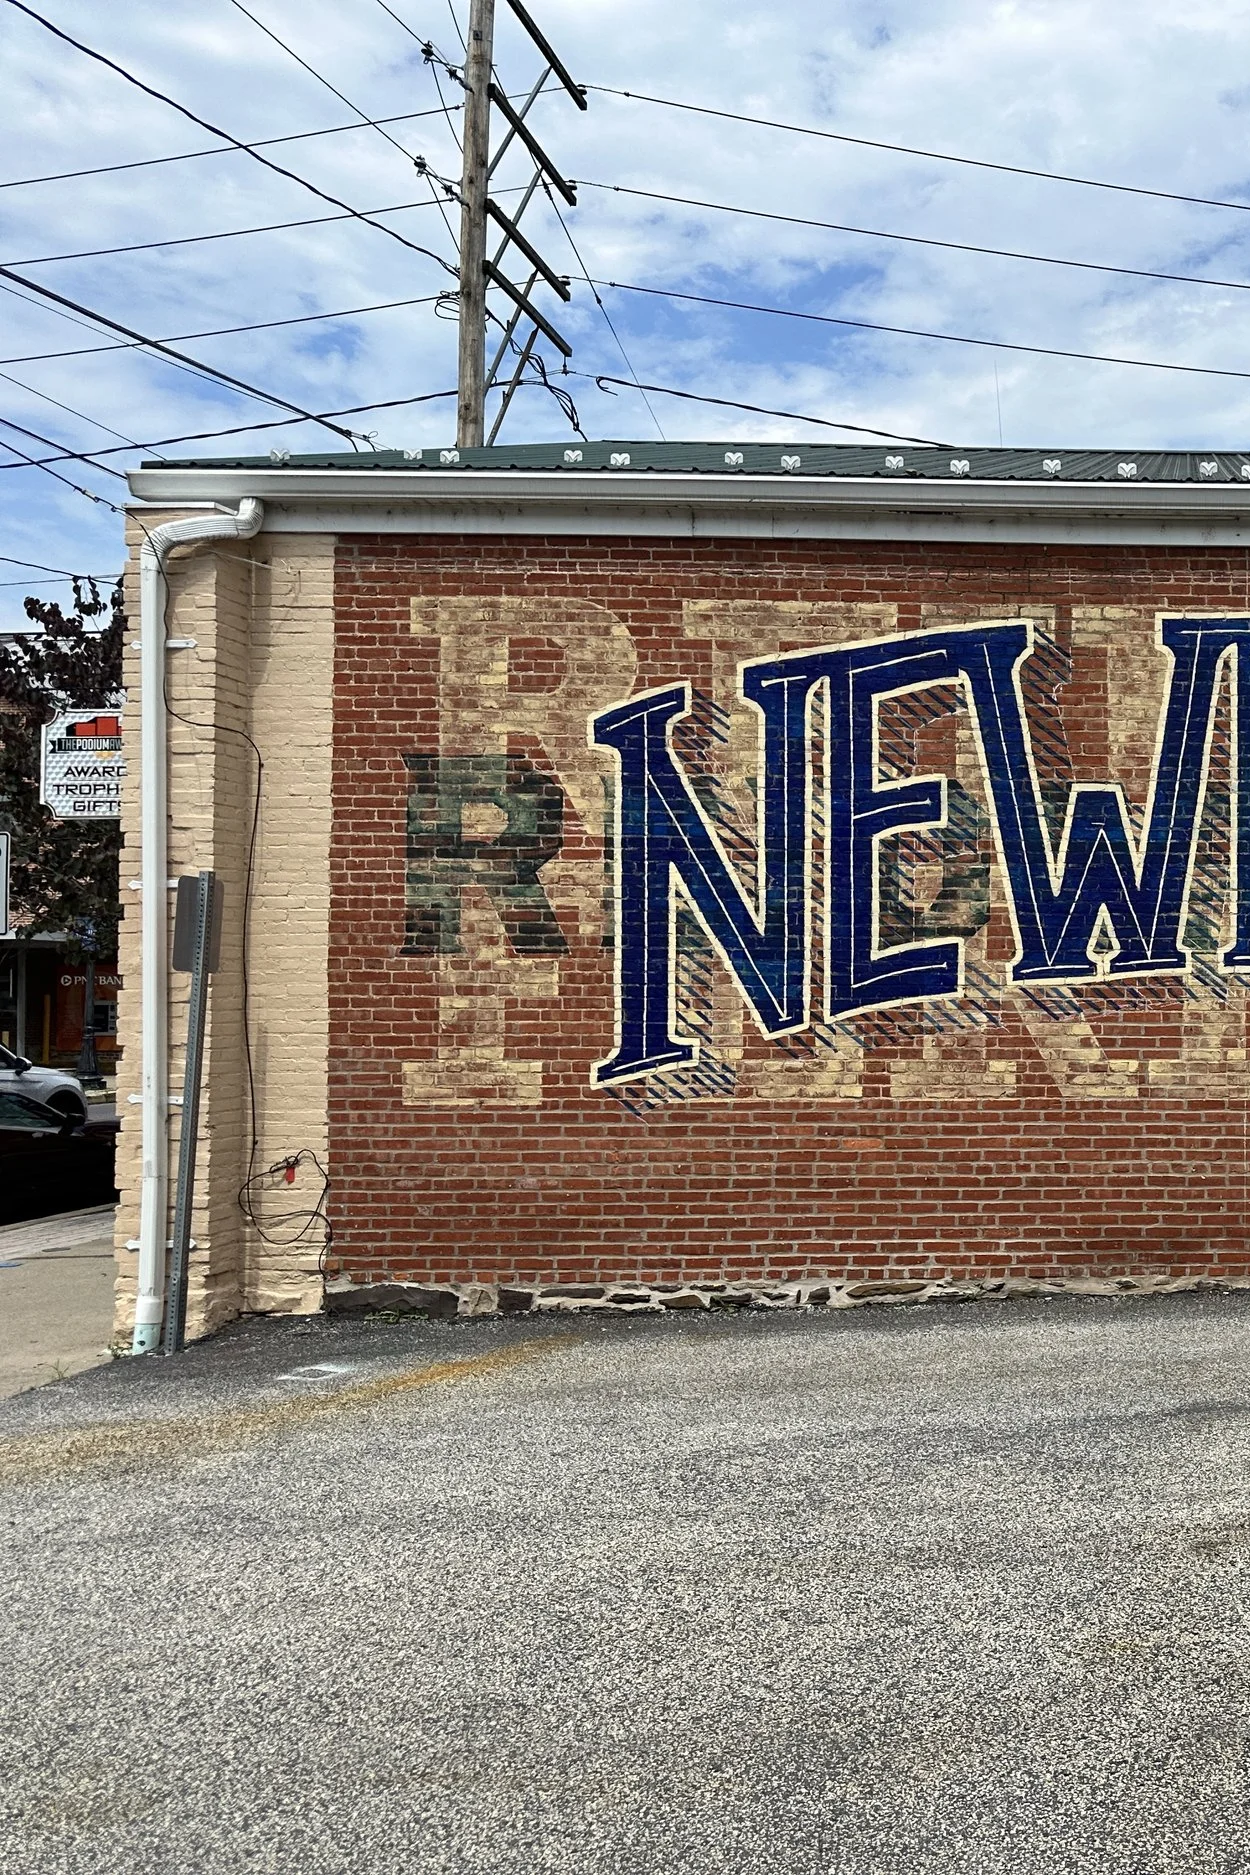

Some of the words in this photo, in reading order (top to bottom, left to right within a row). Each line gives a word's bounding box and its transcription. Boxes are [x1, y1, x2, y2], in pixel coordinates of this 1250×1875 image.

[61, 738, 121, 750] THEPODIUMAW
[64, 766, 128, 777] AWARD
[53, 784, 120, 795] TROPH
[73, 800, 121, 812] GIFT
[73, 975, 98, 986] PN
[98, 975, 123, 986] BAN
